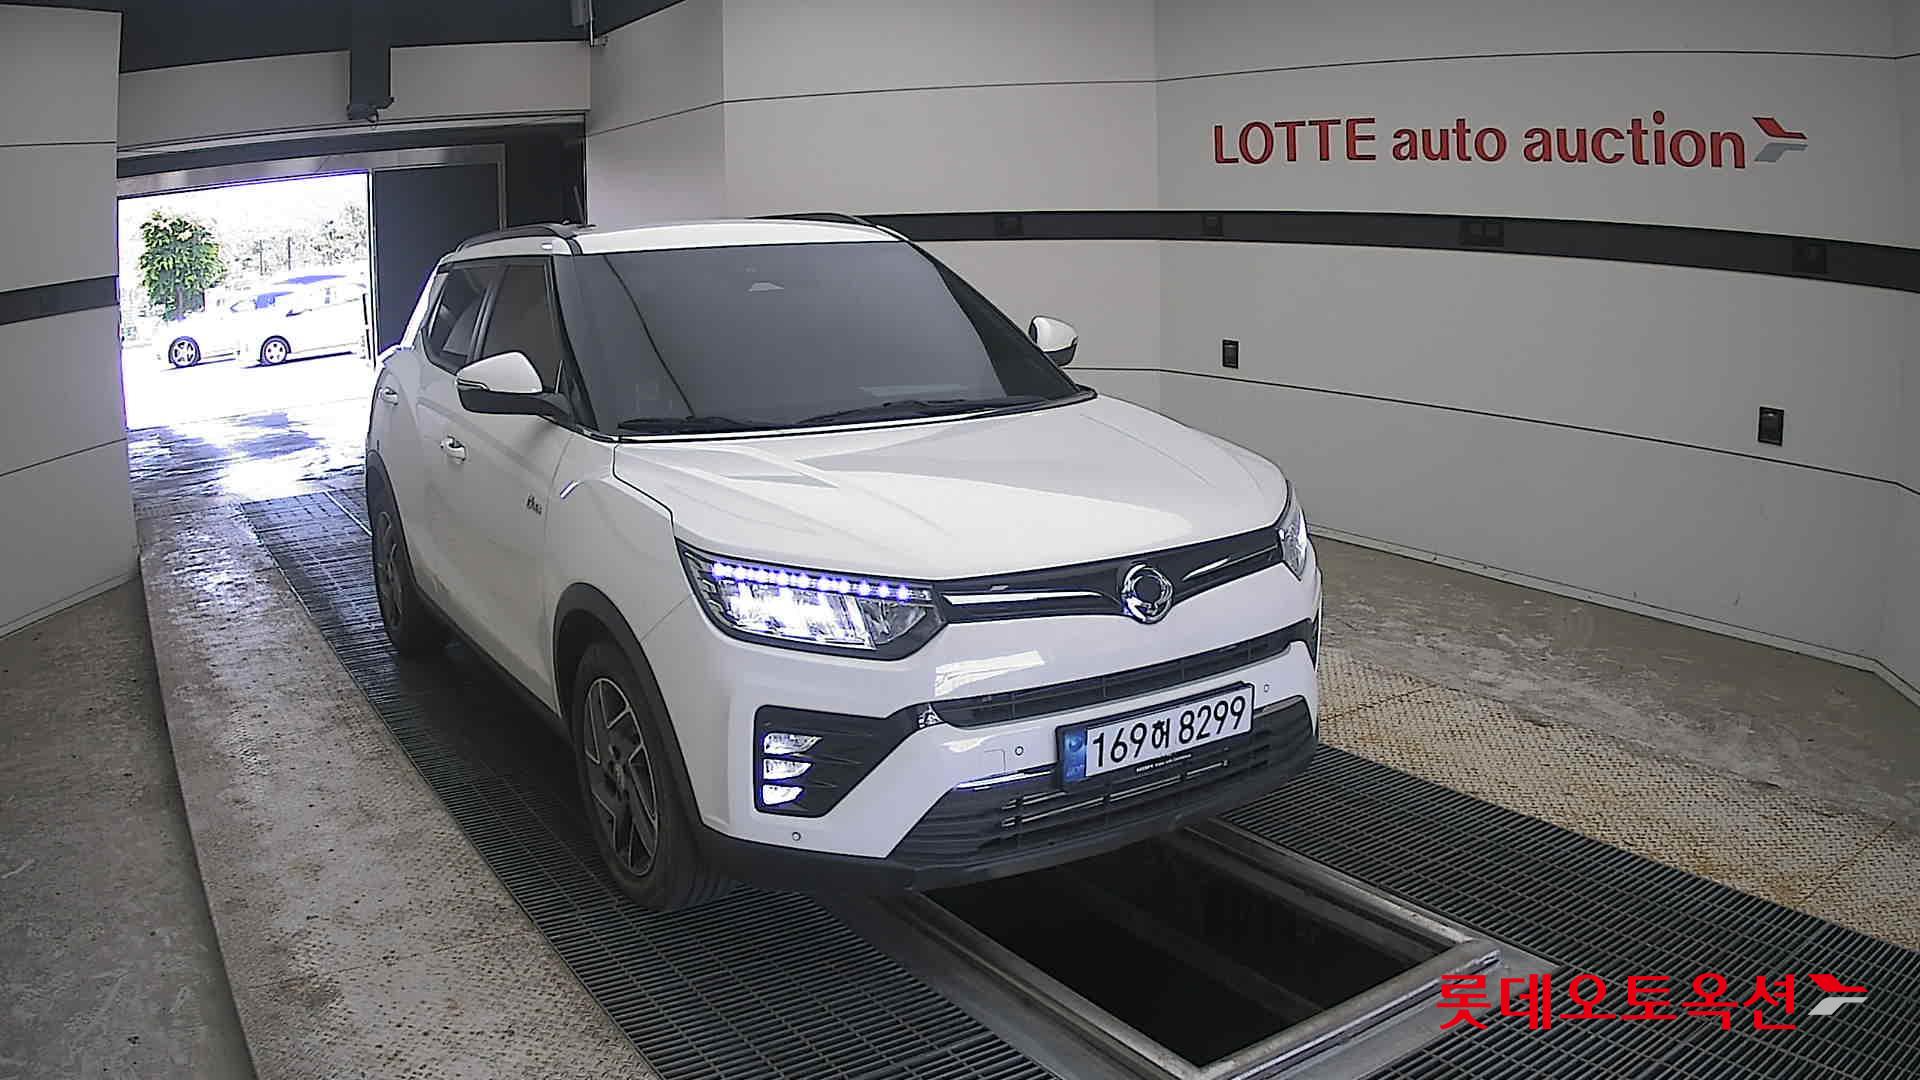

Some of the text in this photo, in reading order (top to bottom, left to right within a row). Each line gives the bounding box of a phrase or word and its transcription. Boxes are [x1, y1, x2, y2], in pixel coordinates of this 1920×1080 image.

[1213, 110, 1746, 169] LOTTE auto auction
[1092, 695, 1246, 768] 169허 8299
